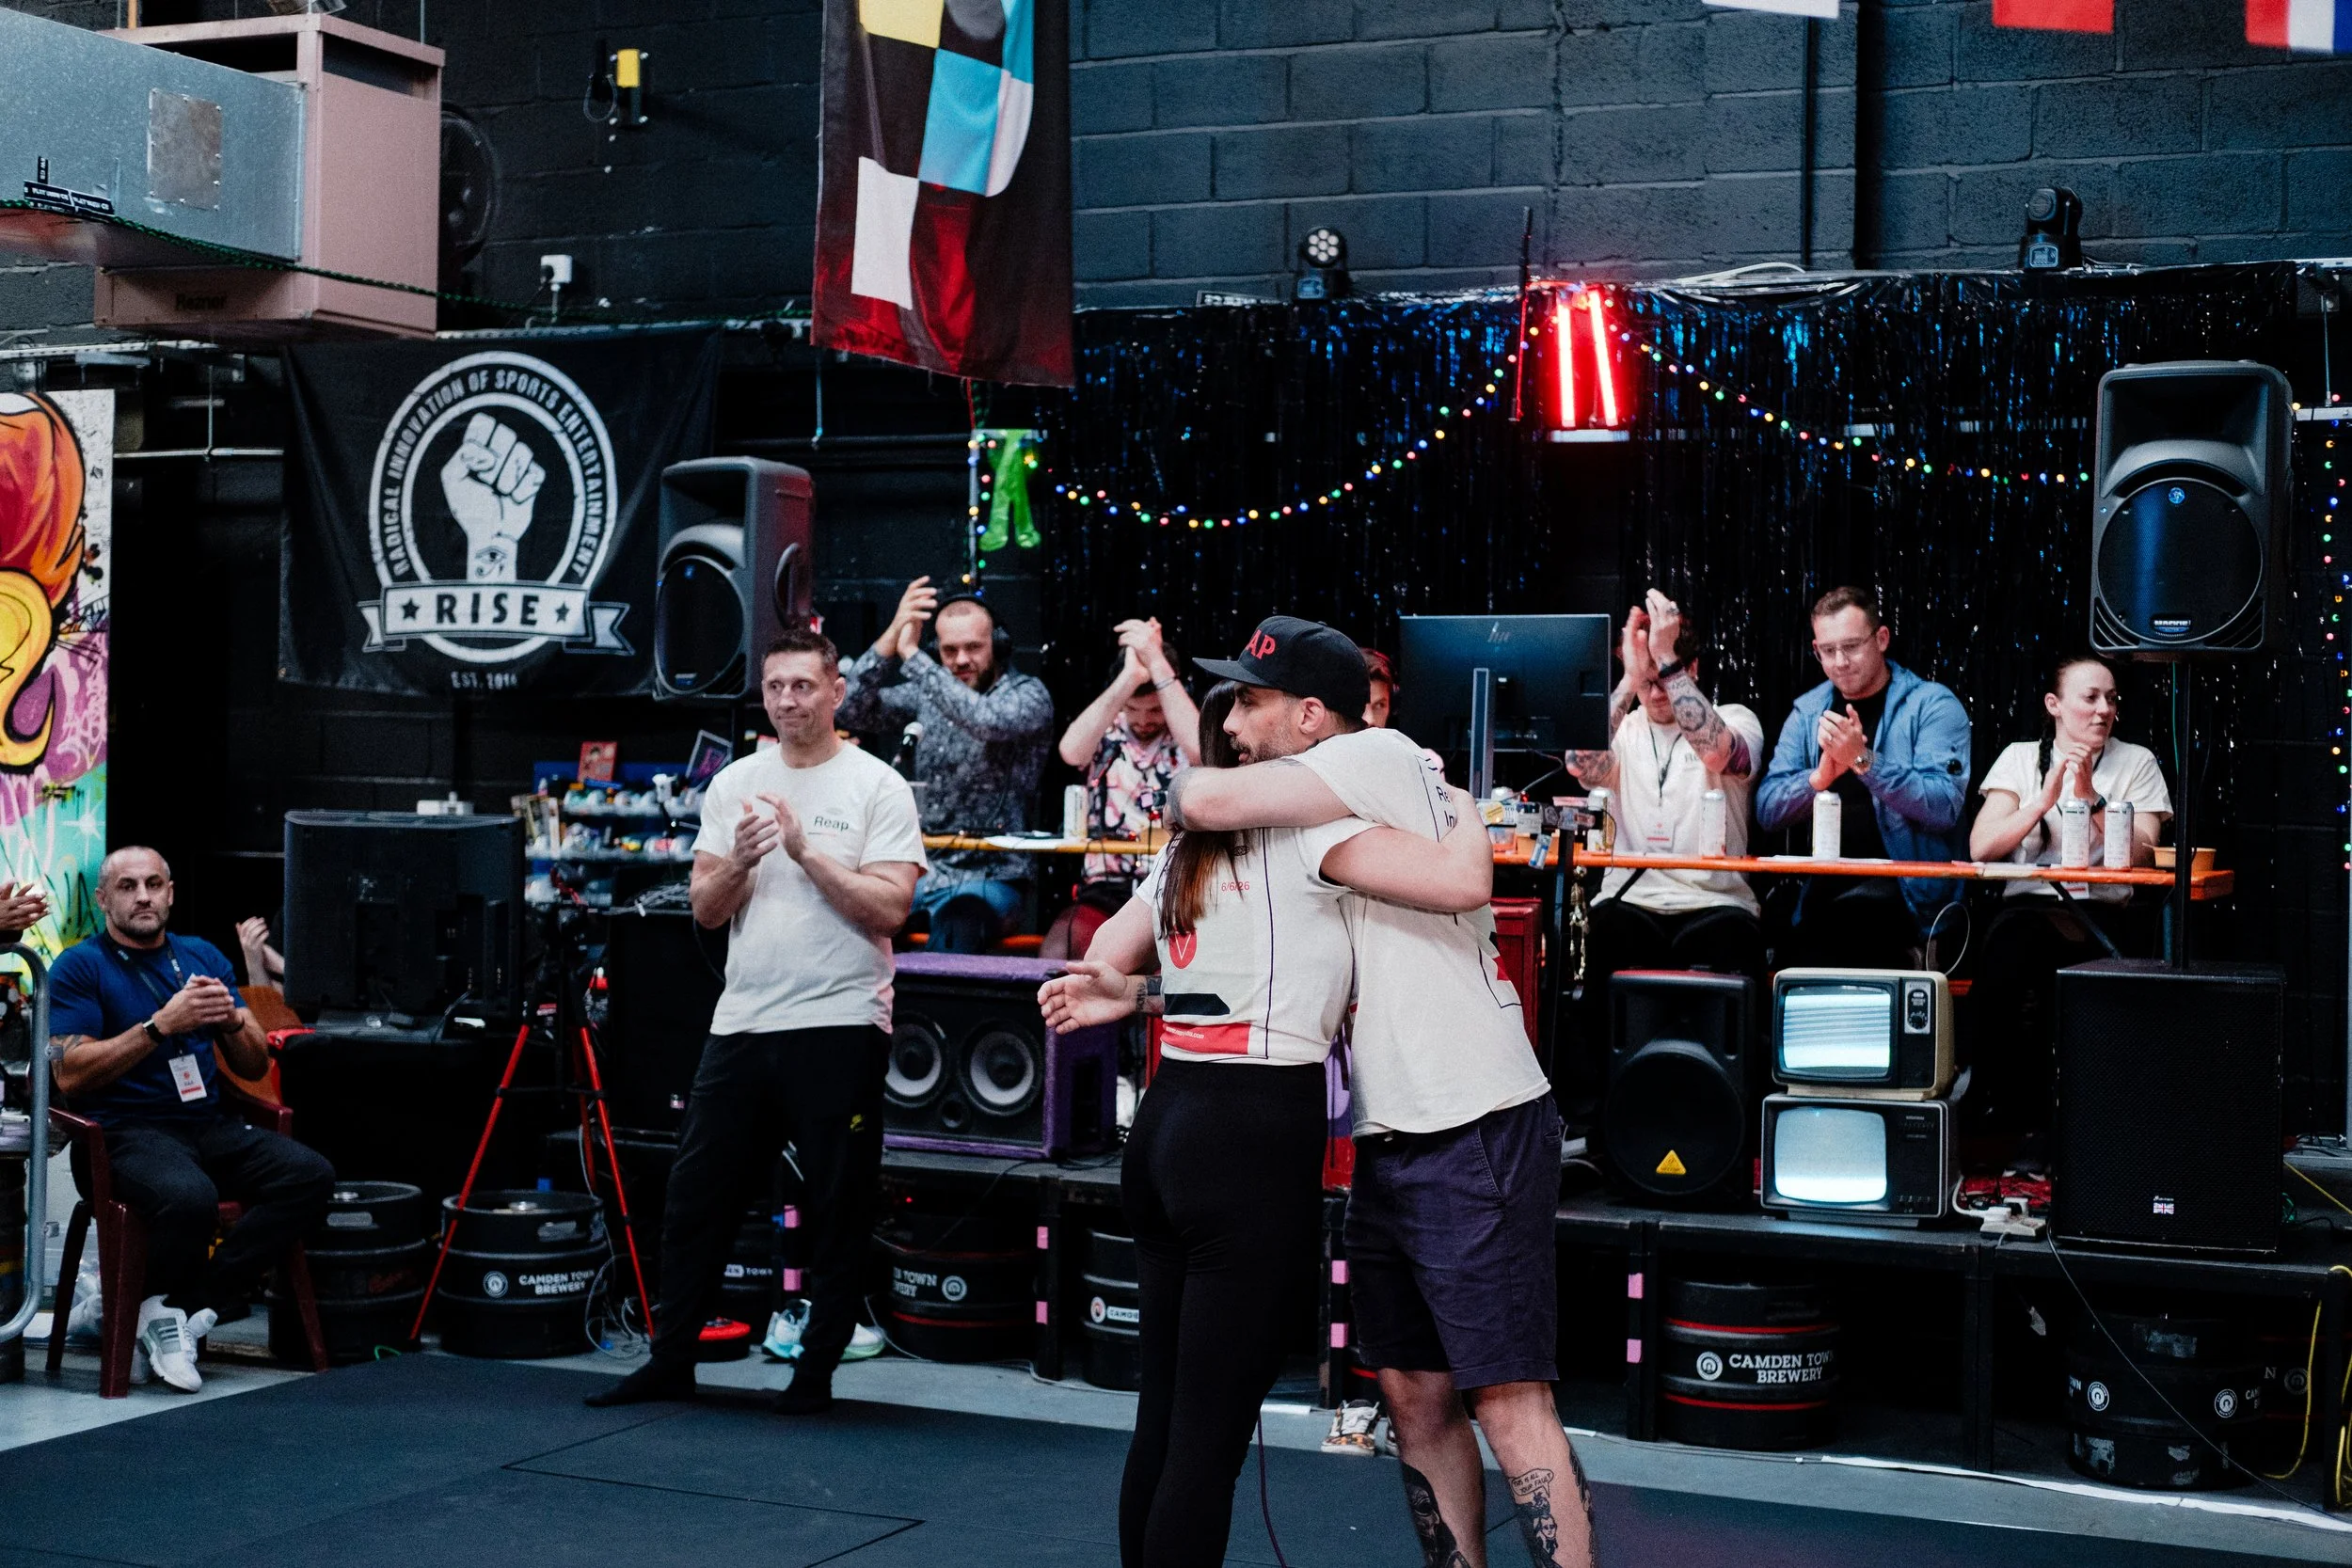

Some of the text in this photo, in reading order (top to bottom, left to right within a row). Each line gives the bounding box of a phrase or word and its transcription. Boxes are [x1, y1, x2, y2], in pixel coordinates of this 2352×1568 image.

[383, 369, 603, 578] RADICAL INNOVATION OF SPORTS ENTERTAINMENT
[436, 593, 540, 626] RISE
[1246, 628, 1276, 660] AP
[814, 816, 849, 832] Reap
[1444, 810, 1457, 828] In
[1221, 880, 1249, 892] 6/6/26
[517, 1273, 569, 1286] CAMDEN
[534, 1281, 586, 1296] BREWERY
[1728, 1354, 1803, 1370] CAMDEN
[1756, 1367, 1823, 1384] BREWERY
[1534, 1472, 1551, 1486] FAULT
